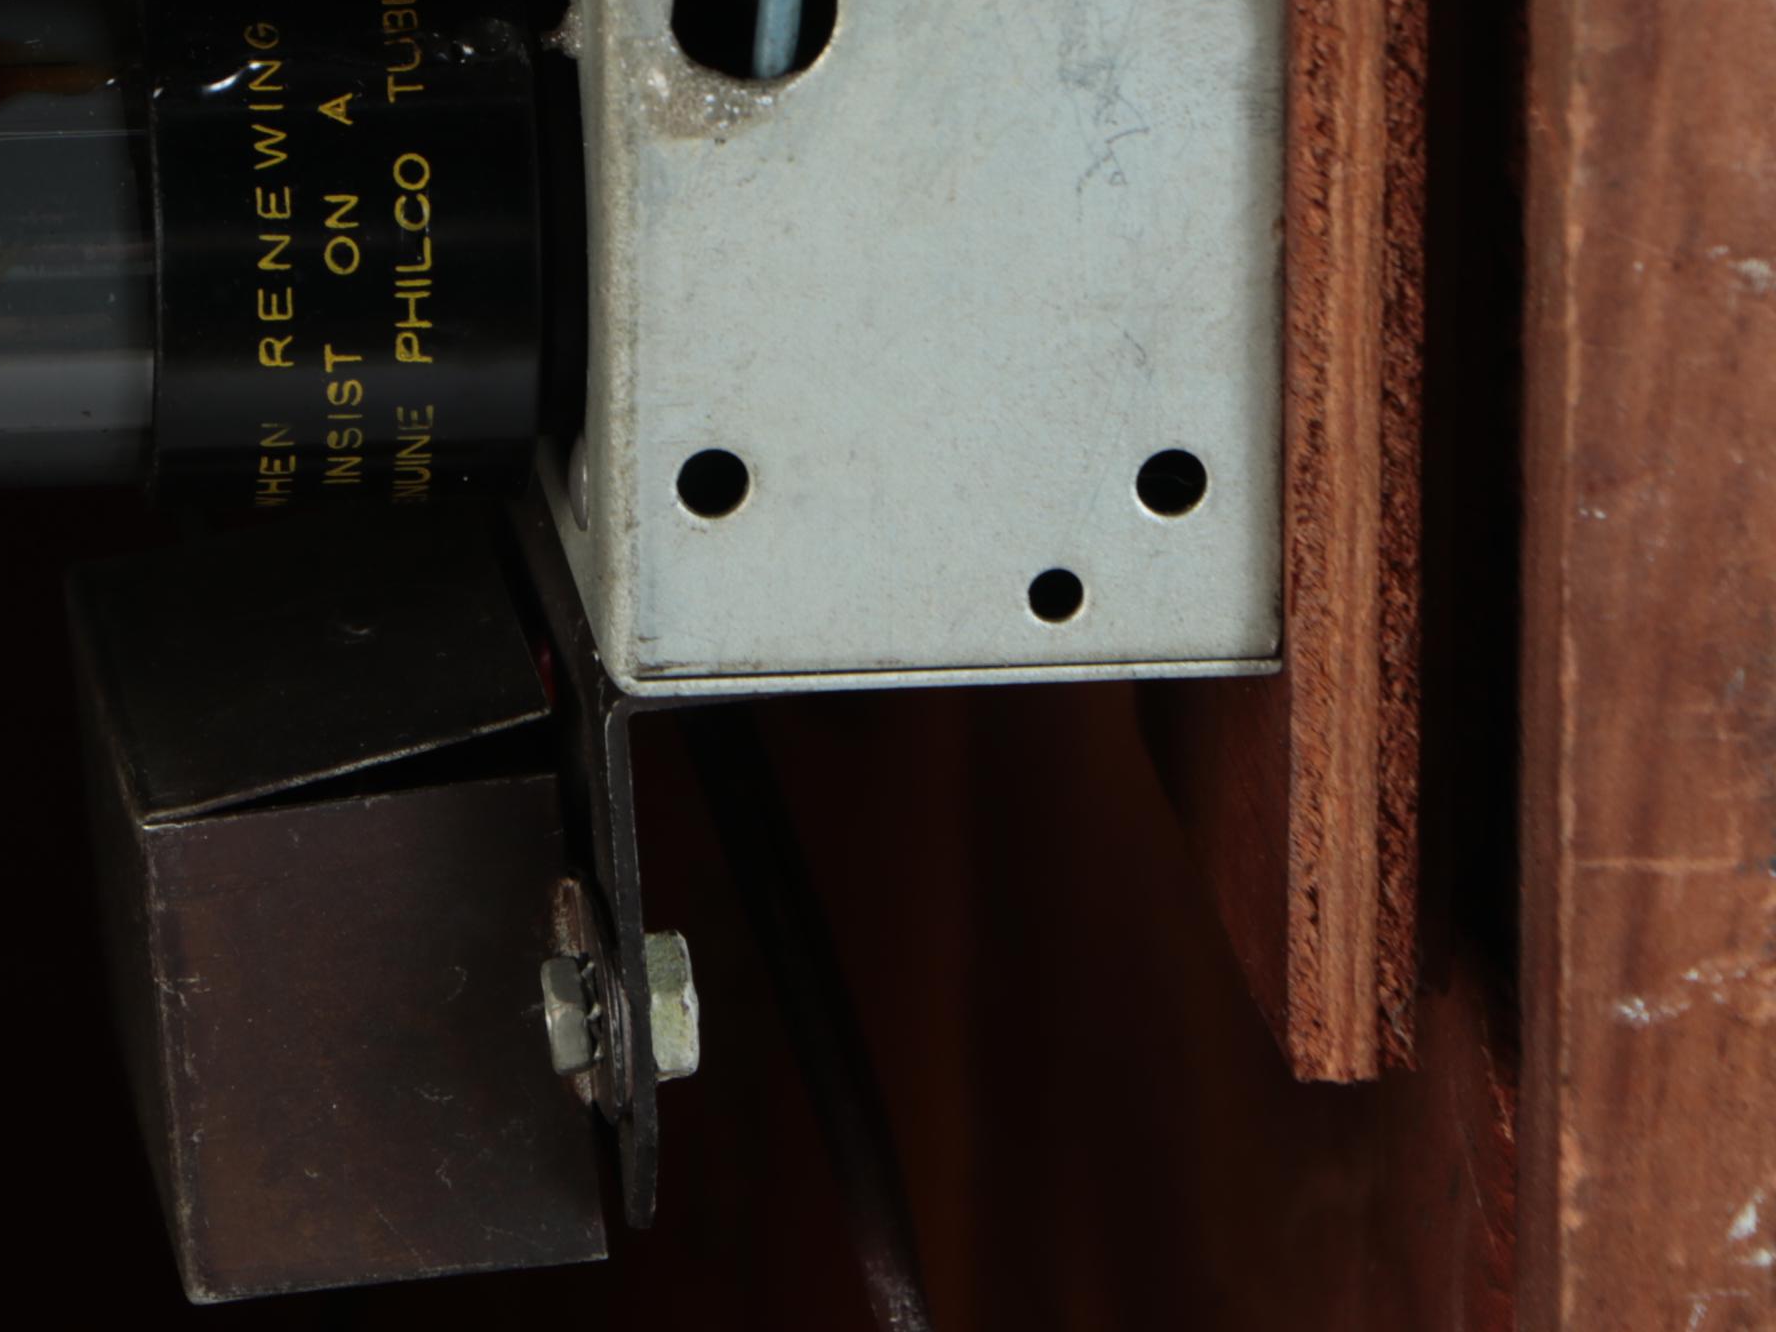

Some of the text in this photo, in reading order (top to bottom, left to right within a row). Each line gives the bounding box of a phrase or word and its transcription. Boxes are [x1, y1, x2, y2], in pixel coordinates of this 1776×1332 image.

[244, 21, 295, 367] RENEWING
[317, 92, 363, 484] INSIST ON A
[392, 151, 433, 363] PHILCO
